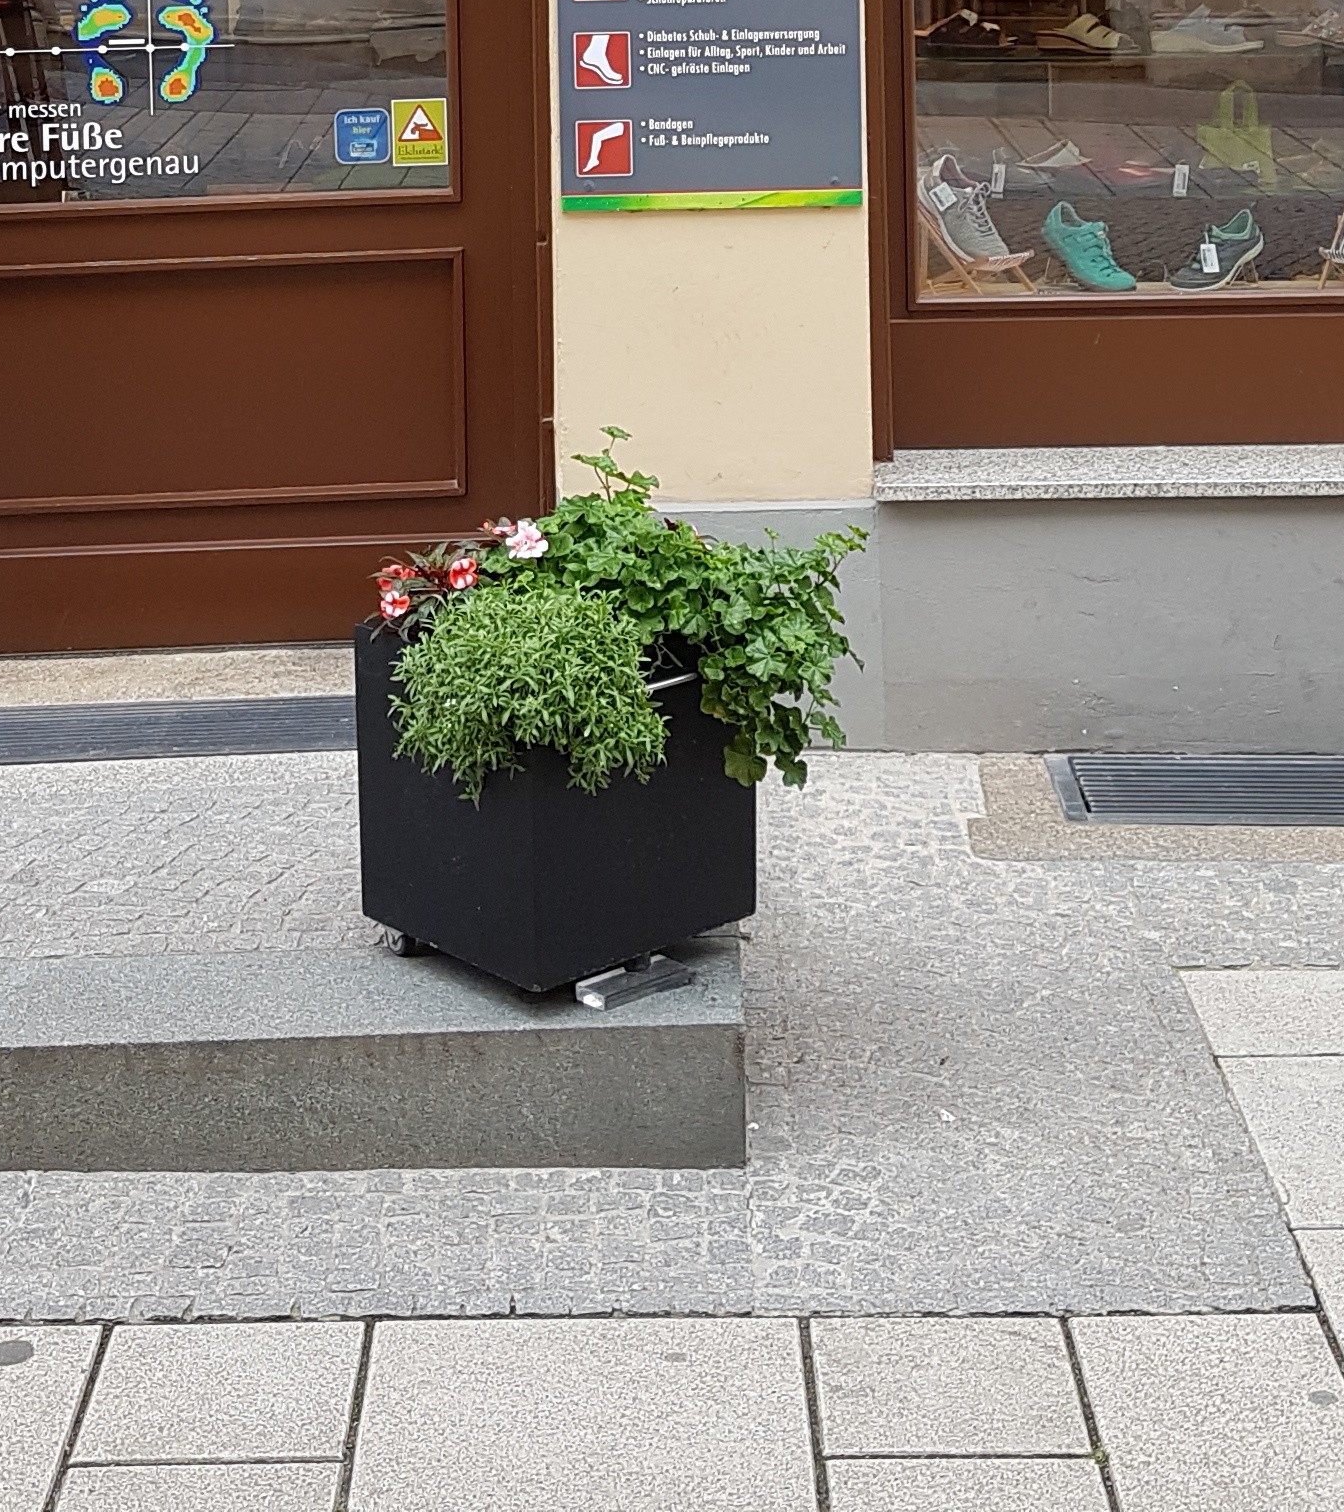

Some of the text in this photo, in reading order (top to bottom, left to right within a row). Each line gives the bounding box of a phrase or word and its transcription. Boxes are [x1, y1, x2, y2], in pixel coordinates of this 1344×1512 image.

[647, 28, 820, 43] Diabetes Schuh- & Einlagenversorgung
[647, 42, 846, 60] Einlagen für Alltag, Sport, Kinder und Arbeit
[671, 62, 709, 77] gefräste
[711, 61, 751, 76] Einlagen
[8, 103, 82, 119] messen
[359, 114, 381, 124] kauf
[649, 118, 693, 131] Bandagen
[42, 121, 123, 152] Füße
[649, 133, 769, 148] Fuß- & Beinpflegeprodukte
